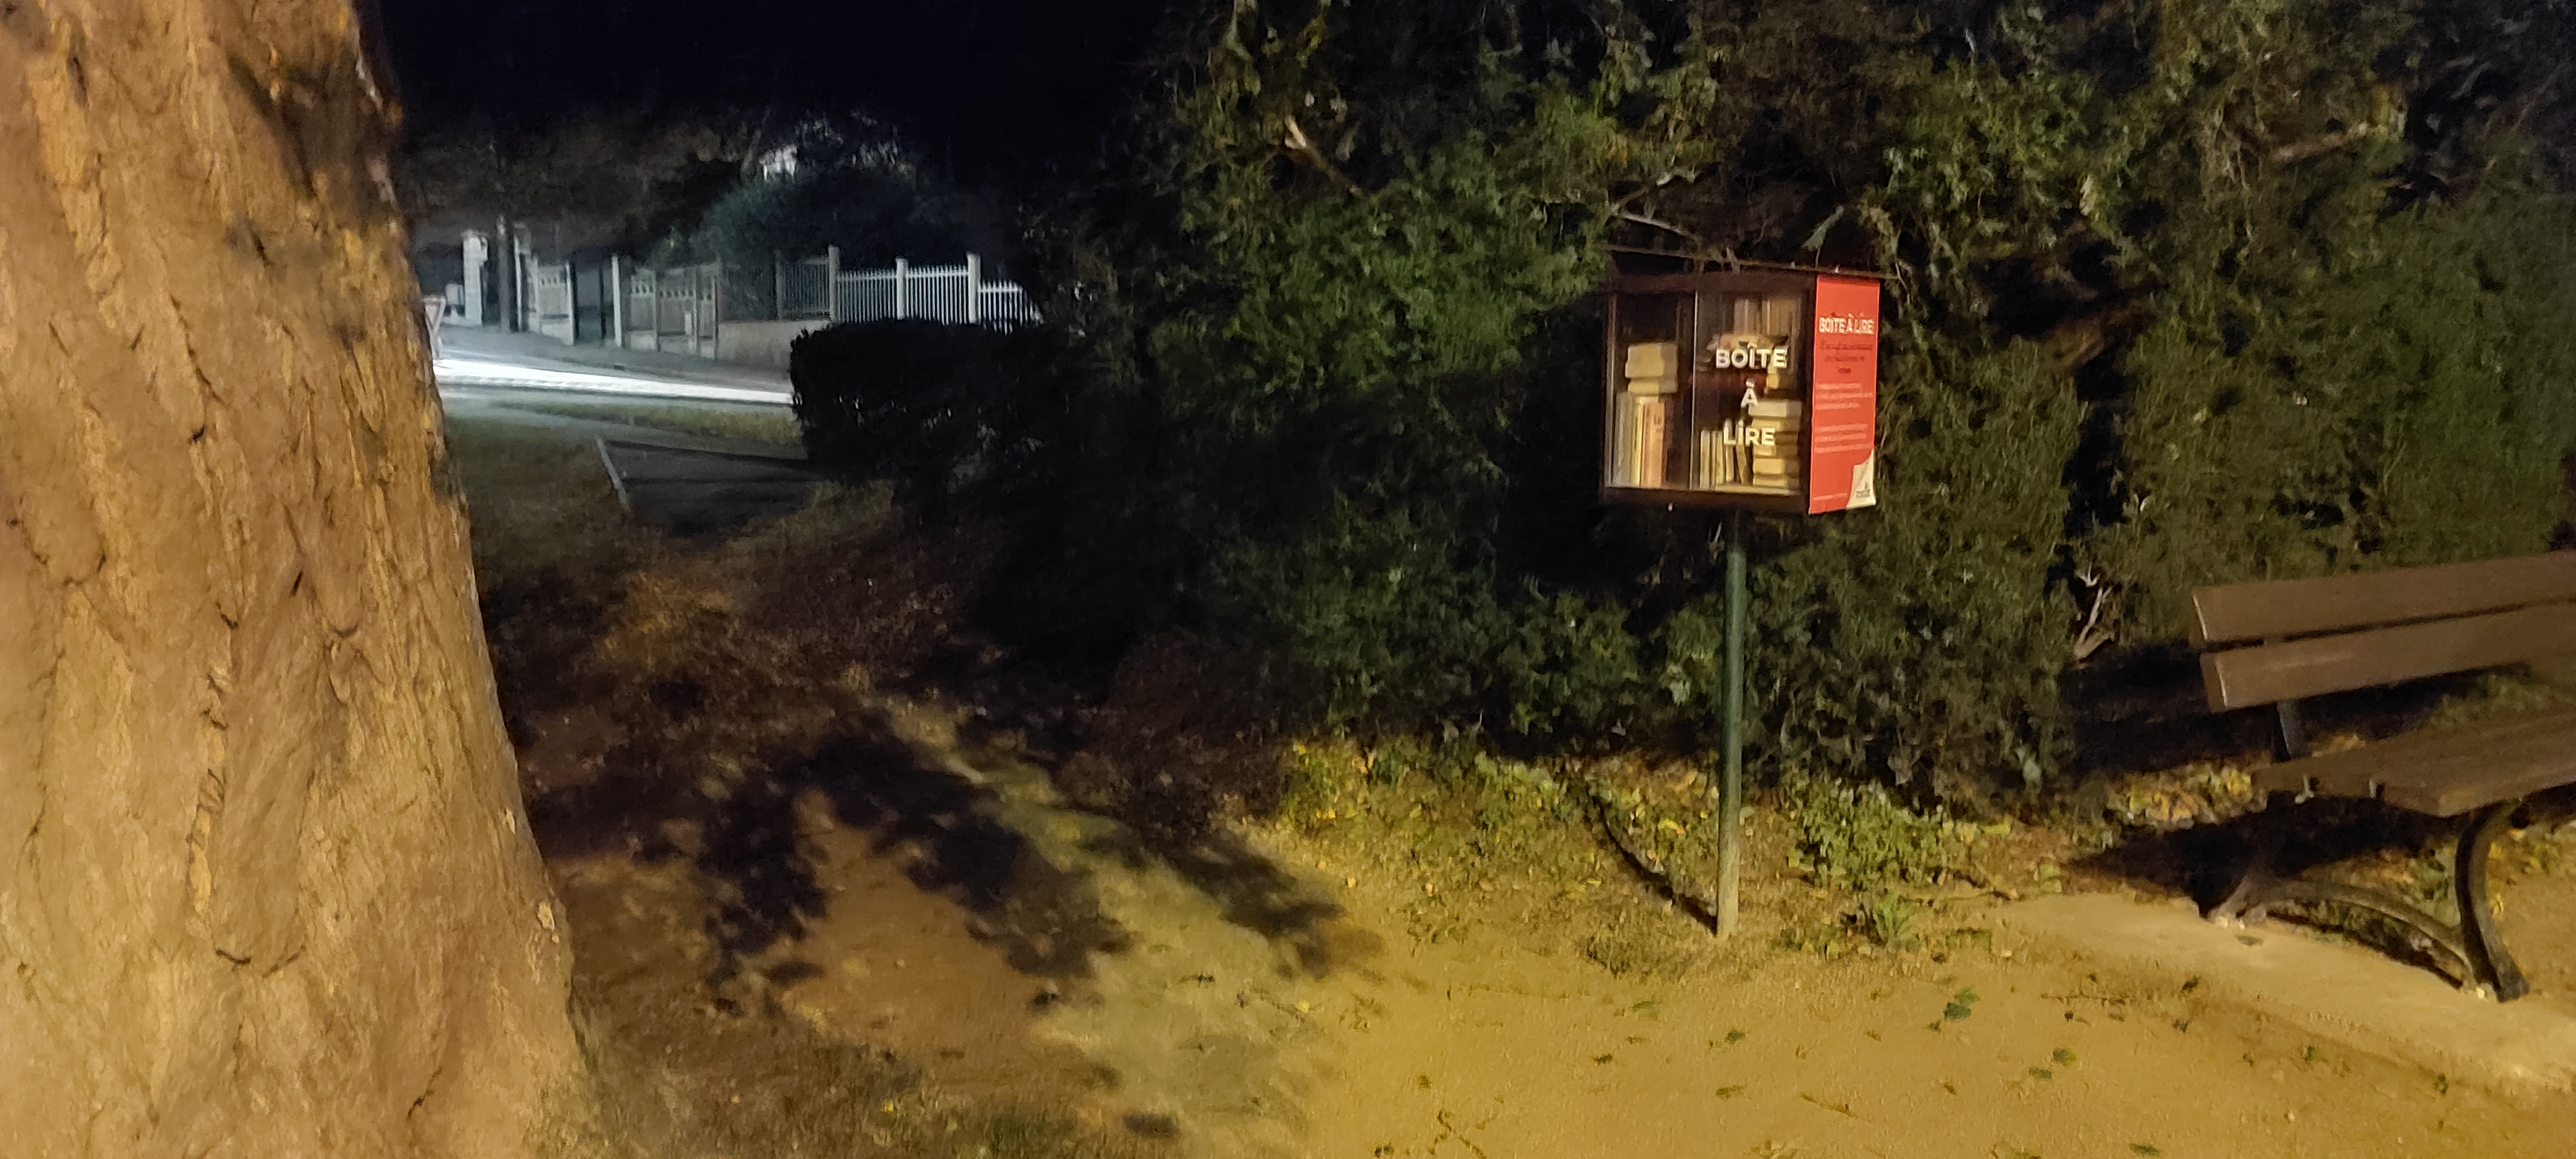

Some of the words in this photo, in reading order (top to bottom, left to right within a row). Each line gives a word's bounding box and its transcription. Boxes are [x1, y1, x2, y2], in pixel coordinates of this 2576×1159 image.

[1854, 317, 1875, 335] LIRE
[1716, 343, 1788, 368] BOÎTE
[1741, 379, 1757, 408] À
[1723, 427, 1775, 446] LIRE
